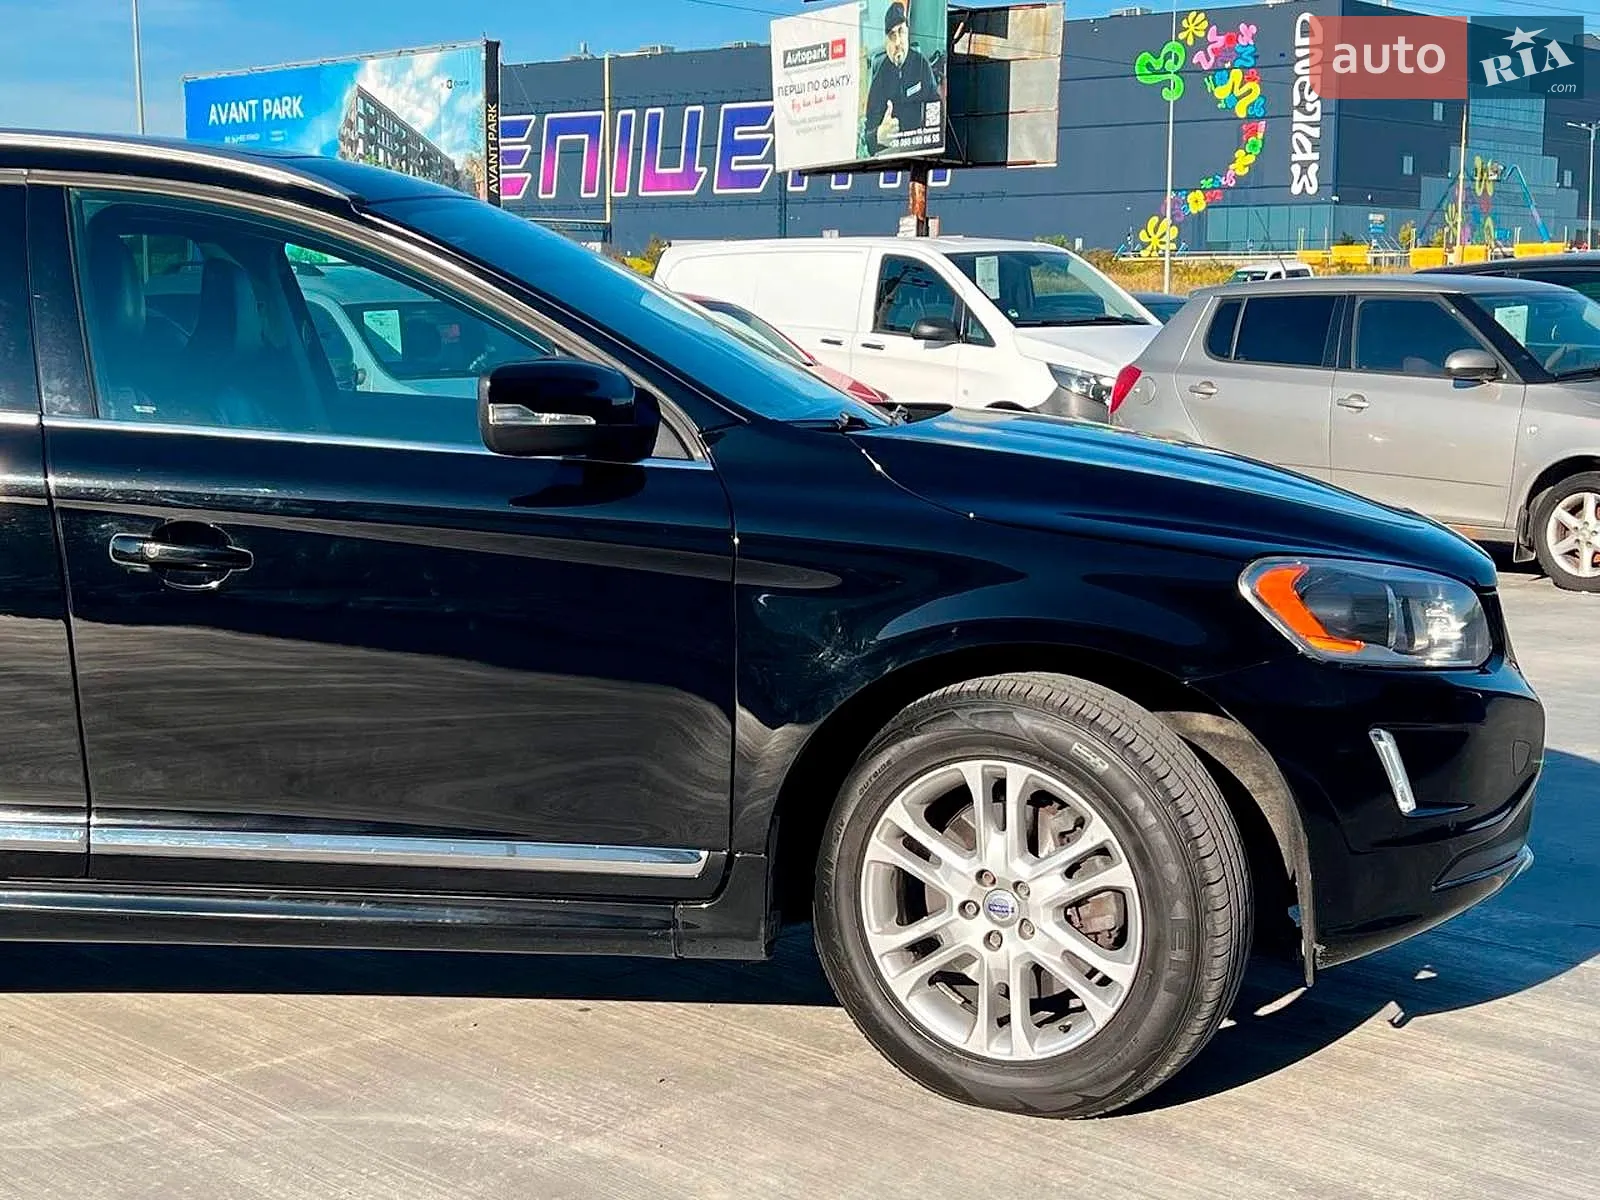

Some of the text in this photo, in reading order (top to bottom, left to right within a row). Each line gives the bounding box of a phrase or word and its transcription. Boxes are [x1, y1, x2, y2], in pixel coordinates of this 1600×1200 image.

[785, 44, 828, 65] Autopark
[777, 81, 806, 97] ПЕРШІ
[807, 79, 820, 93] ПО
[208, 95, 305, 126] AVANT PARK
[487, 103, 499, 194] AVANT PARK
